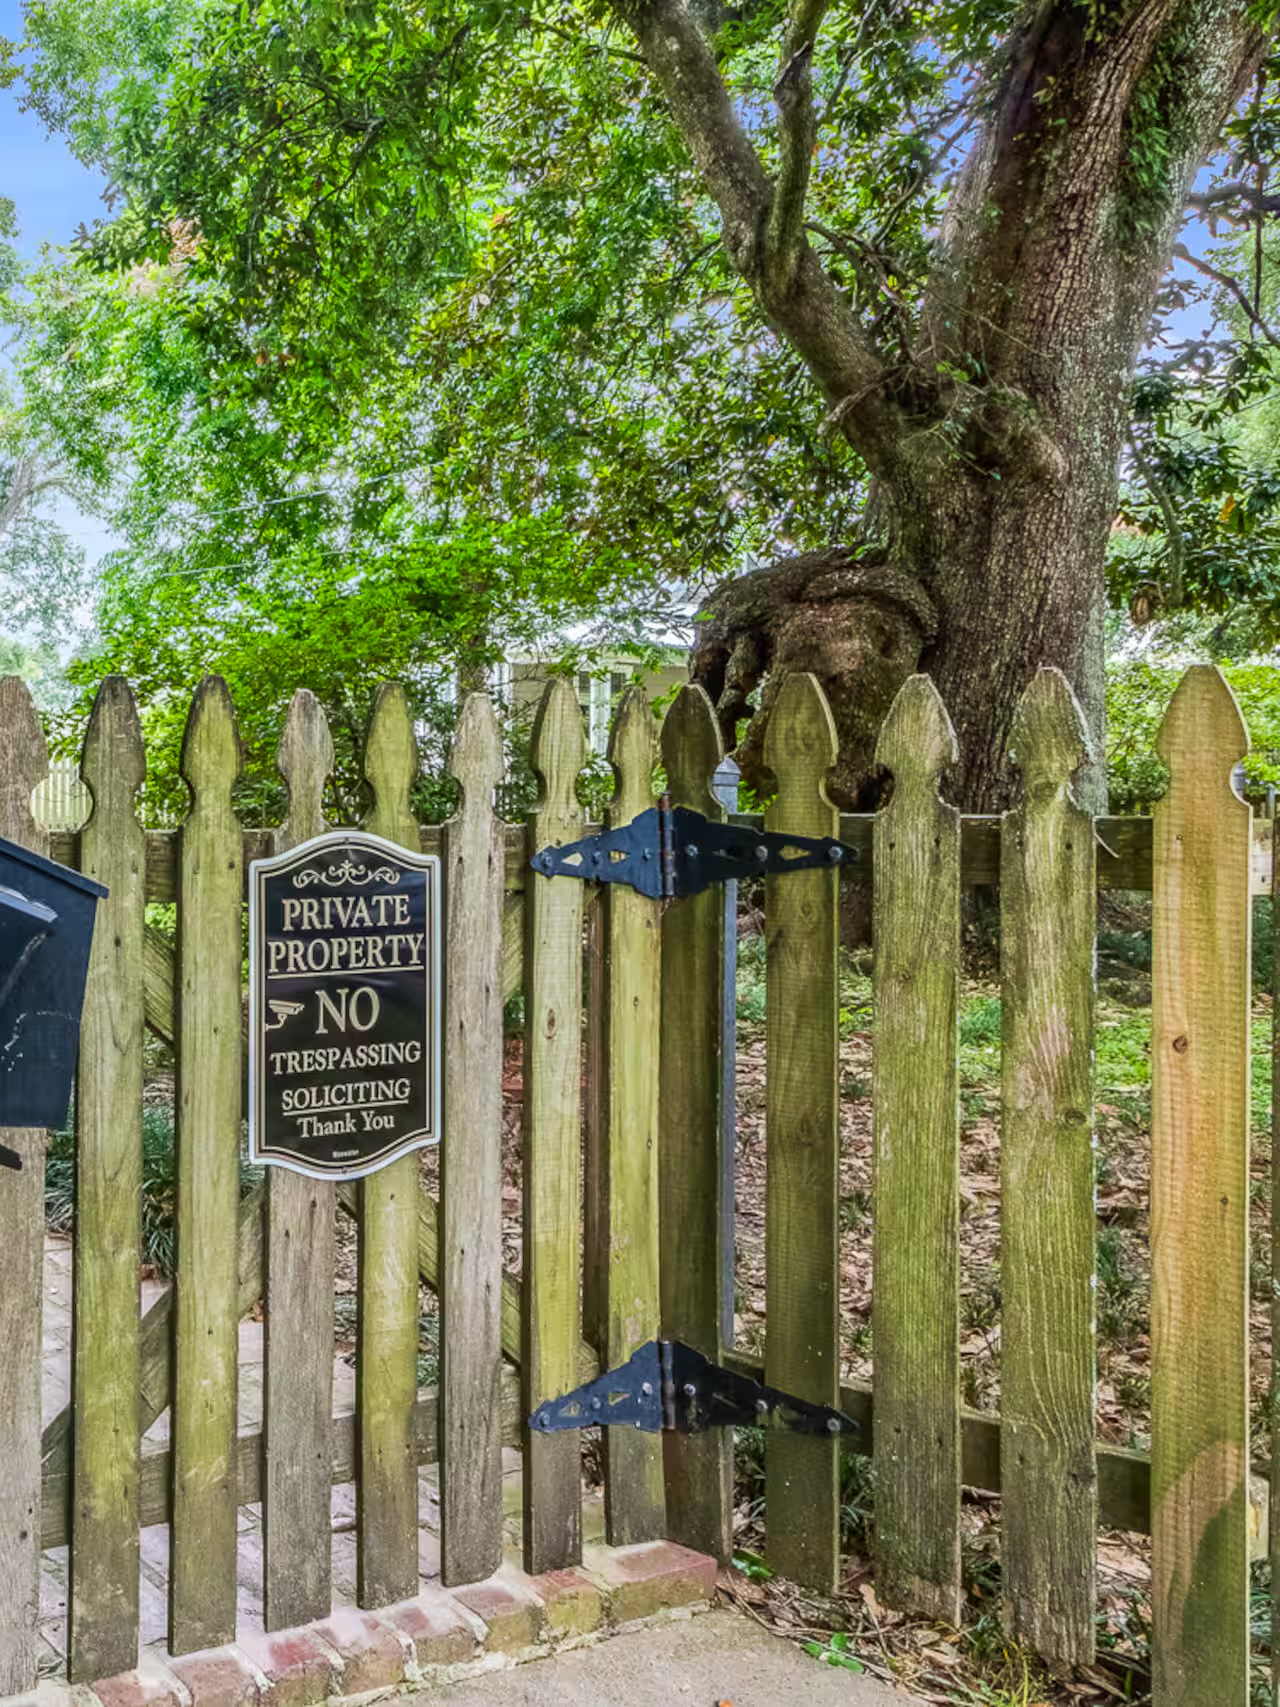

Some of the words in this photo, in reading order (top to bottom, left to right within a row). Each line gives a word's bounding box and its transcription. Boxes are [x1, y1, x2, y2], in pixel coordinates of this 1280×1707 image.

[282, 894, 411, 932] PRIVATE
[268, 933, 424, 974] PROPERTY
[314, 985, 380, 1035] NO
[269, 1041, 421, 1075] TRESPASSING
[281, 1078, 411, 1111] SOLICITING
[296, 1114, 356, 1139] Thank
[361, 1110, 395, 1130] You
